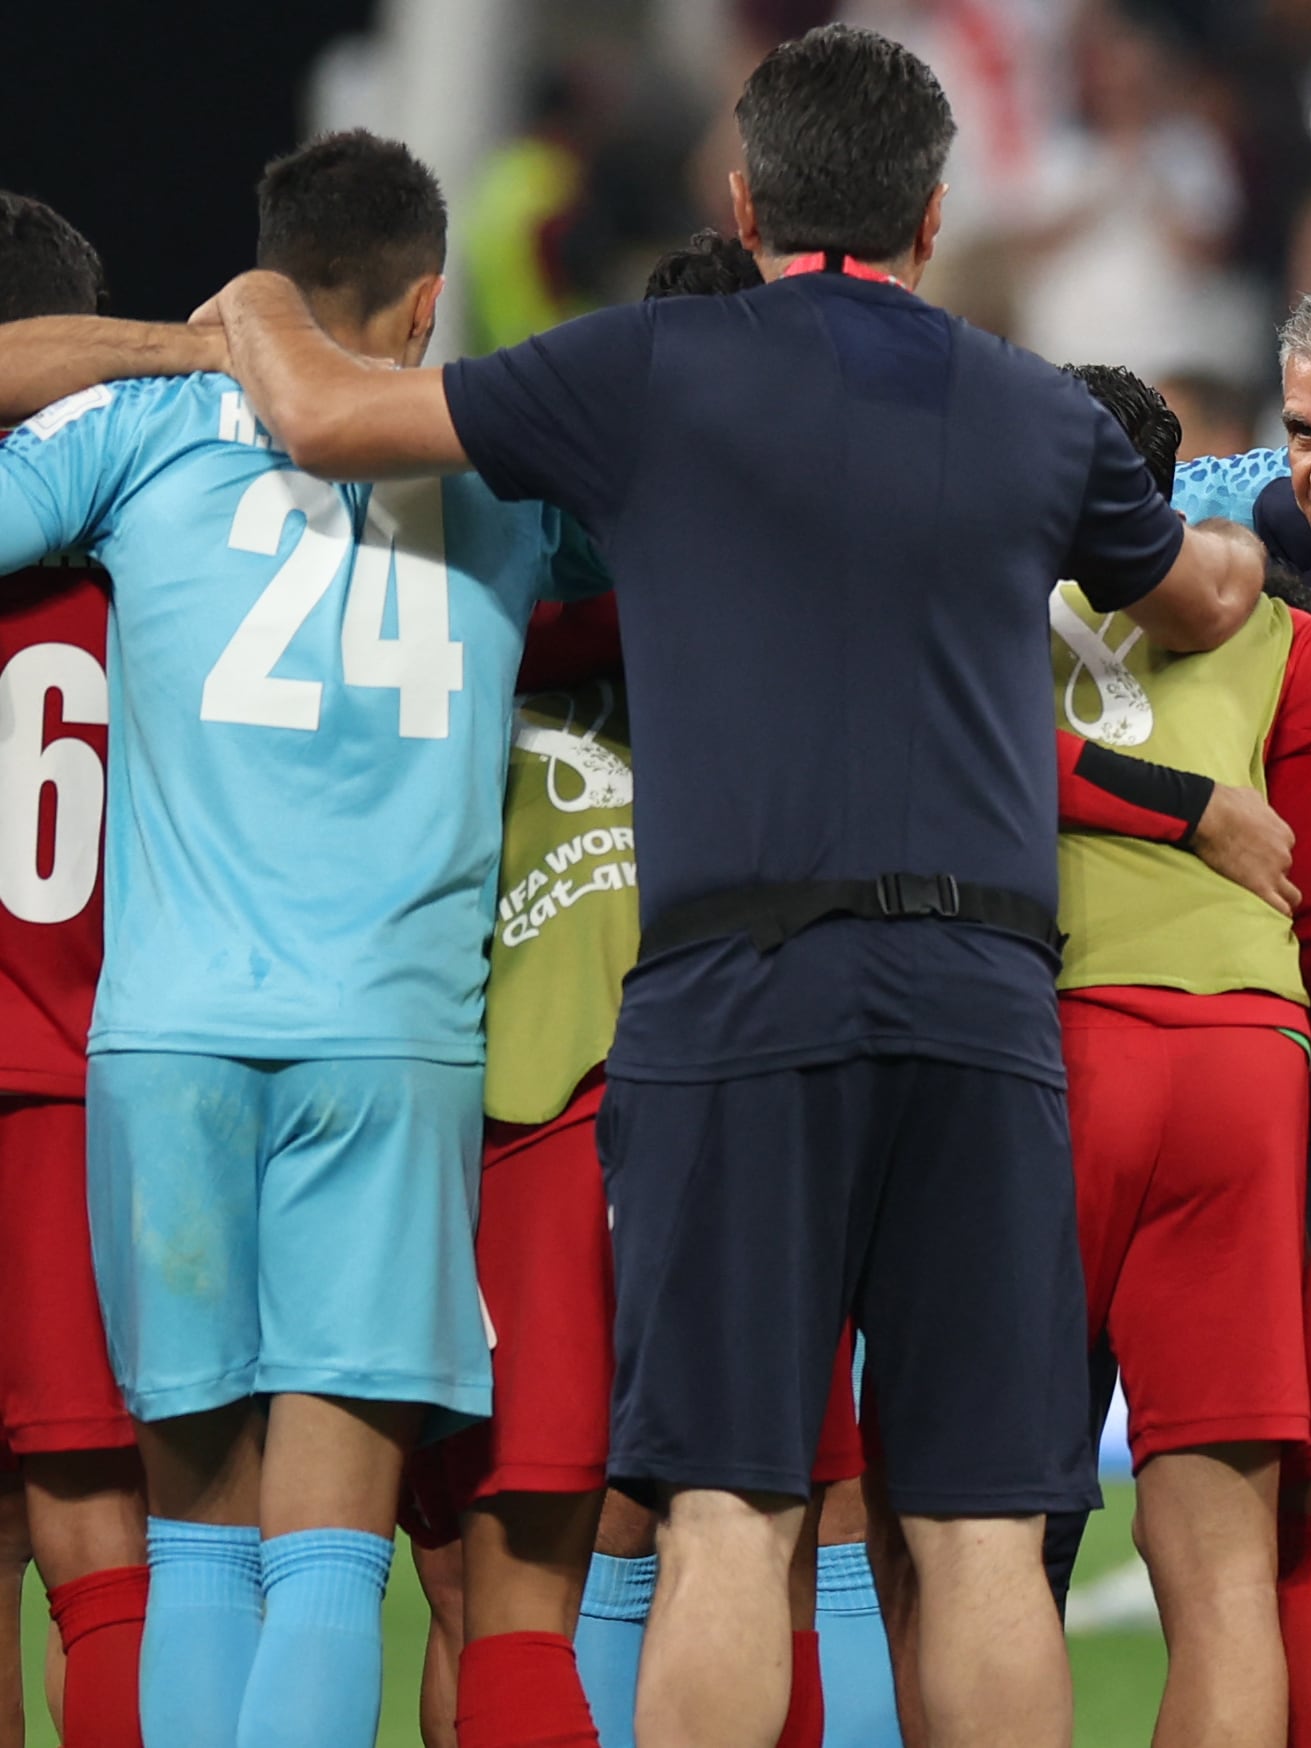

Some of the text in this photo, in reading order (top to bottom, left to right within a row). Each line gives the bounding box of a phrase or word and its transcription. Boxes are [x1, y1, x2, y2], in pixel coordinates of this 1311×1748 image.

[200, 469, 464, 740] 24
[0, 642, 108, 924] 6
[499, 826, 635, 922] IFA WOR
